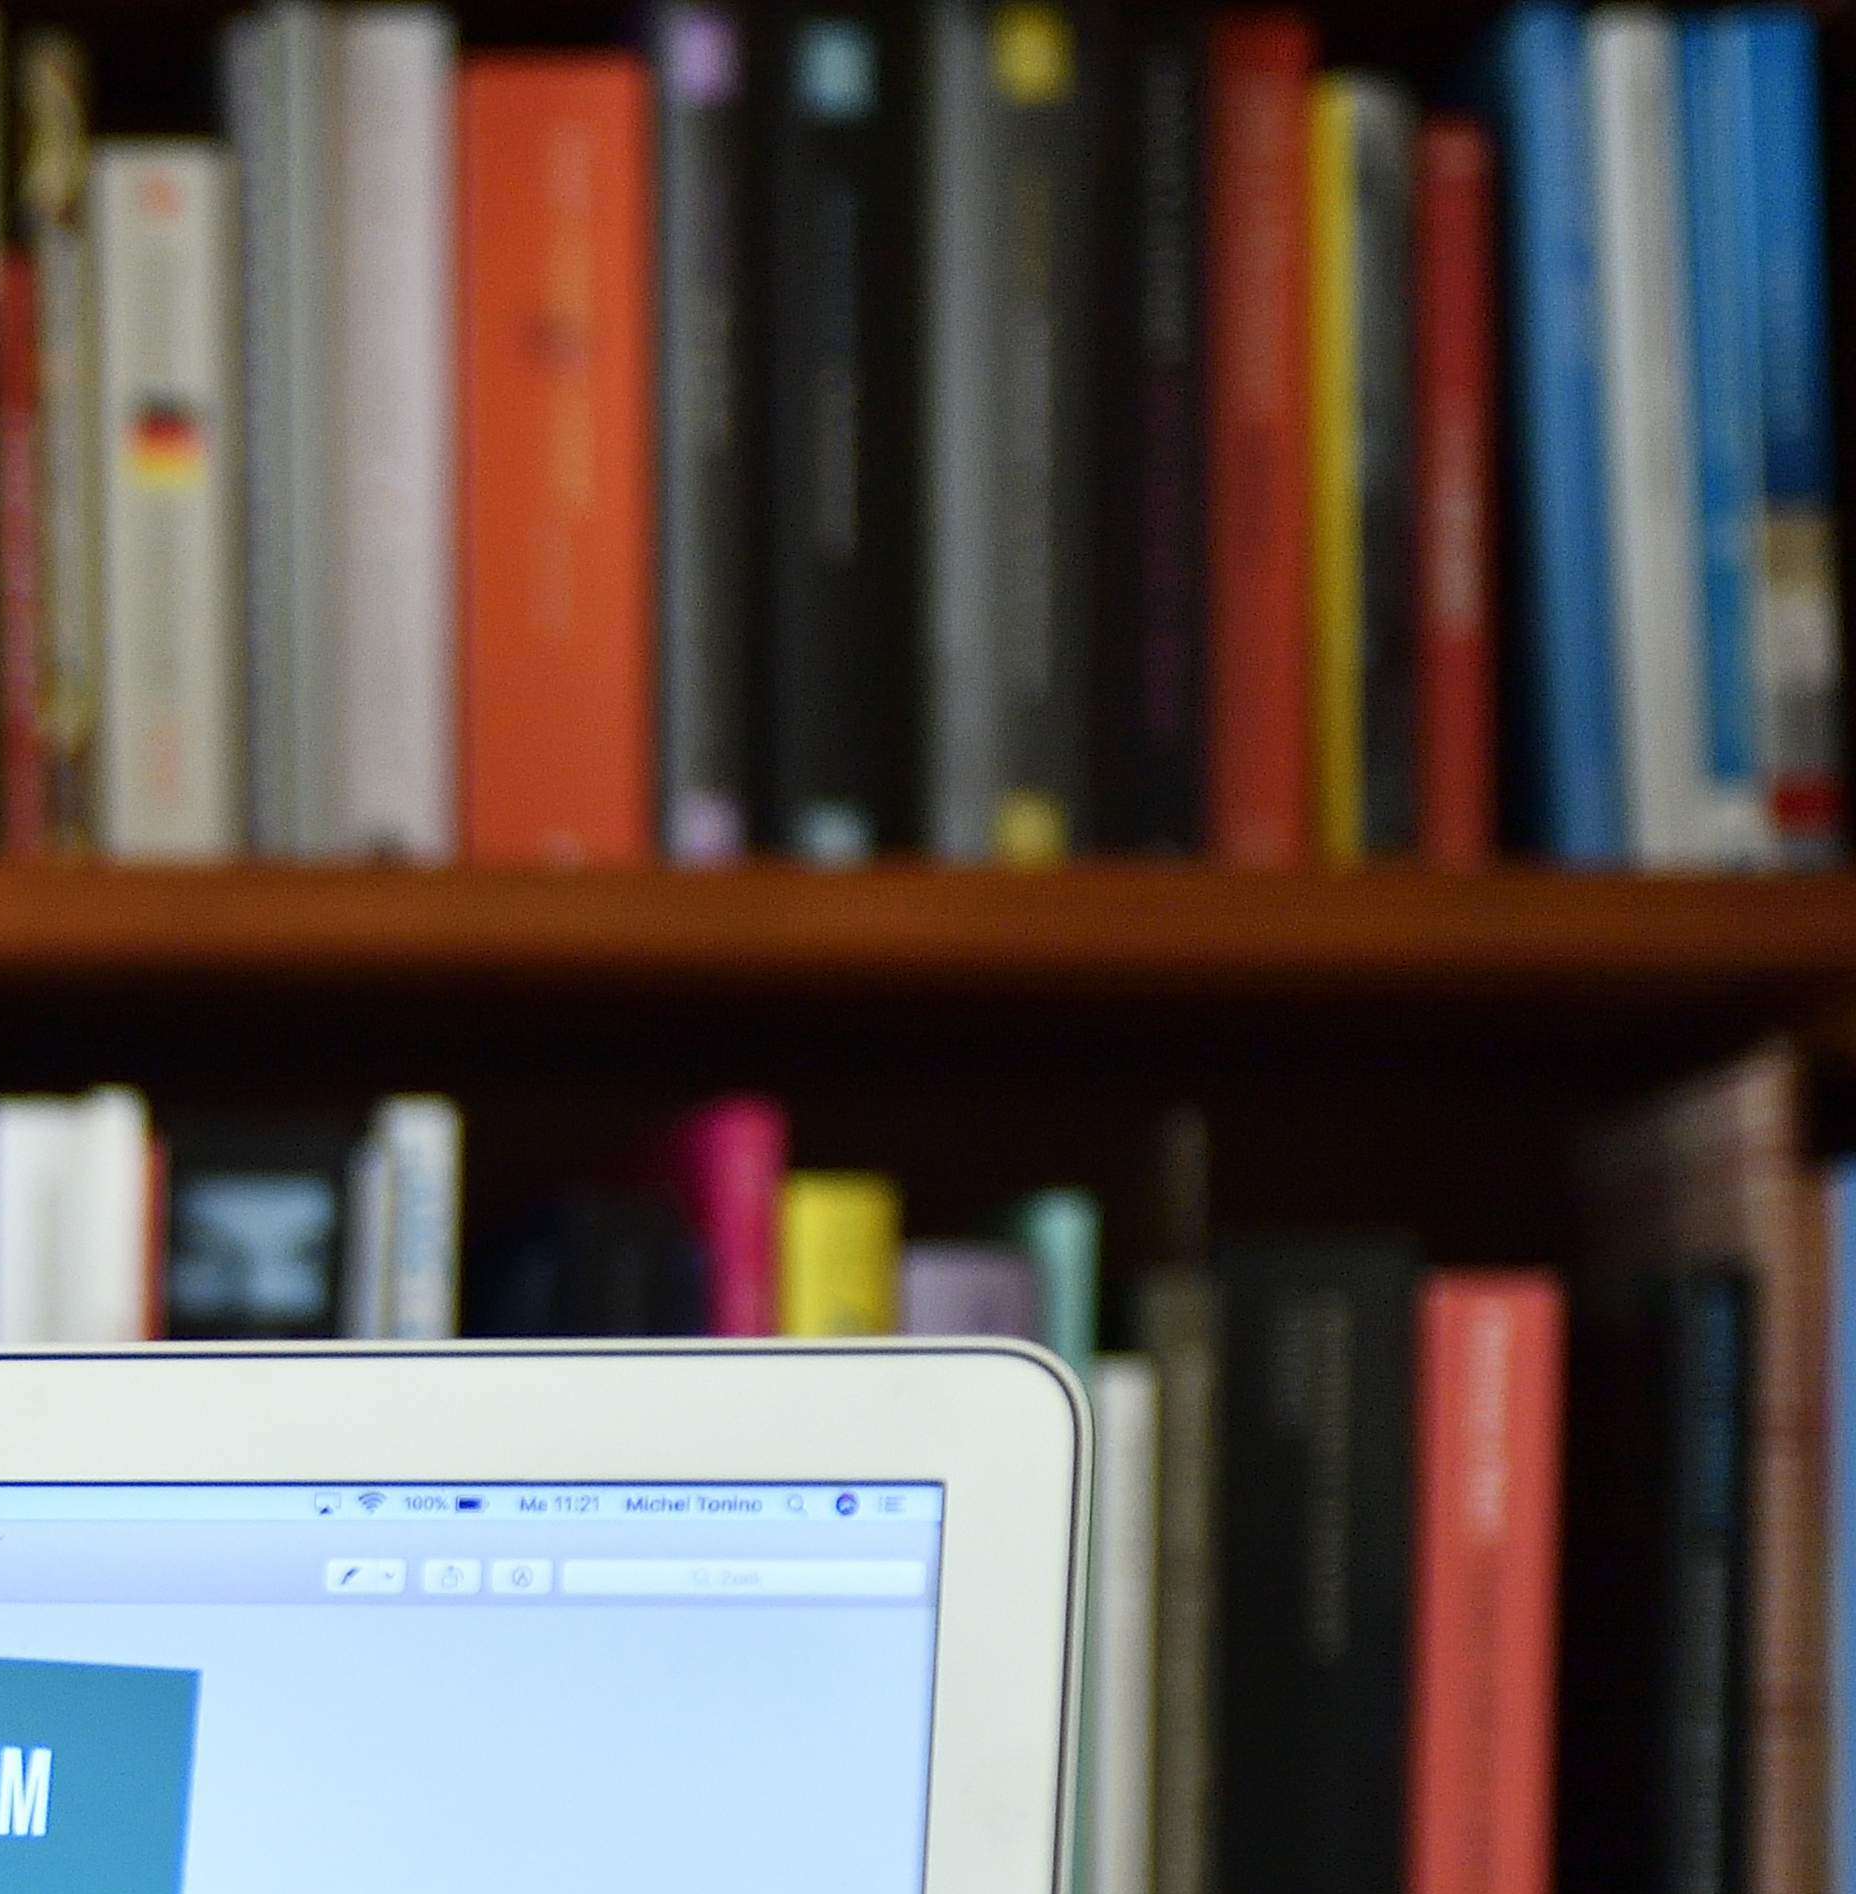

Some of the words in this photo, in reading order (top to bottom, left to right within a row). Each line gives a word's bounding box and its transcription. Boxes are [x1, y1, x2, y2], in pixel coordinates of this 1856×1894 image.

[405, 1496, 449, 1511] 100%
[555, 1495, 600, 1512] 11:21
[626, 1496, 690, 1512] Michel
[698, 1496, 763, 1512] Tonino
